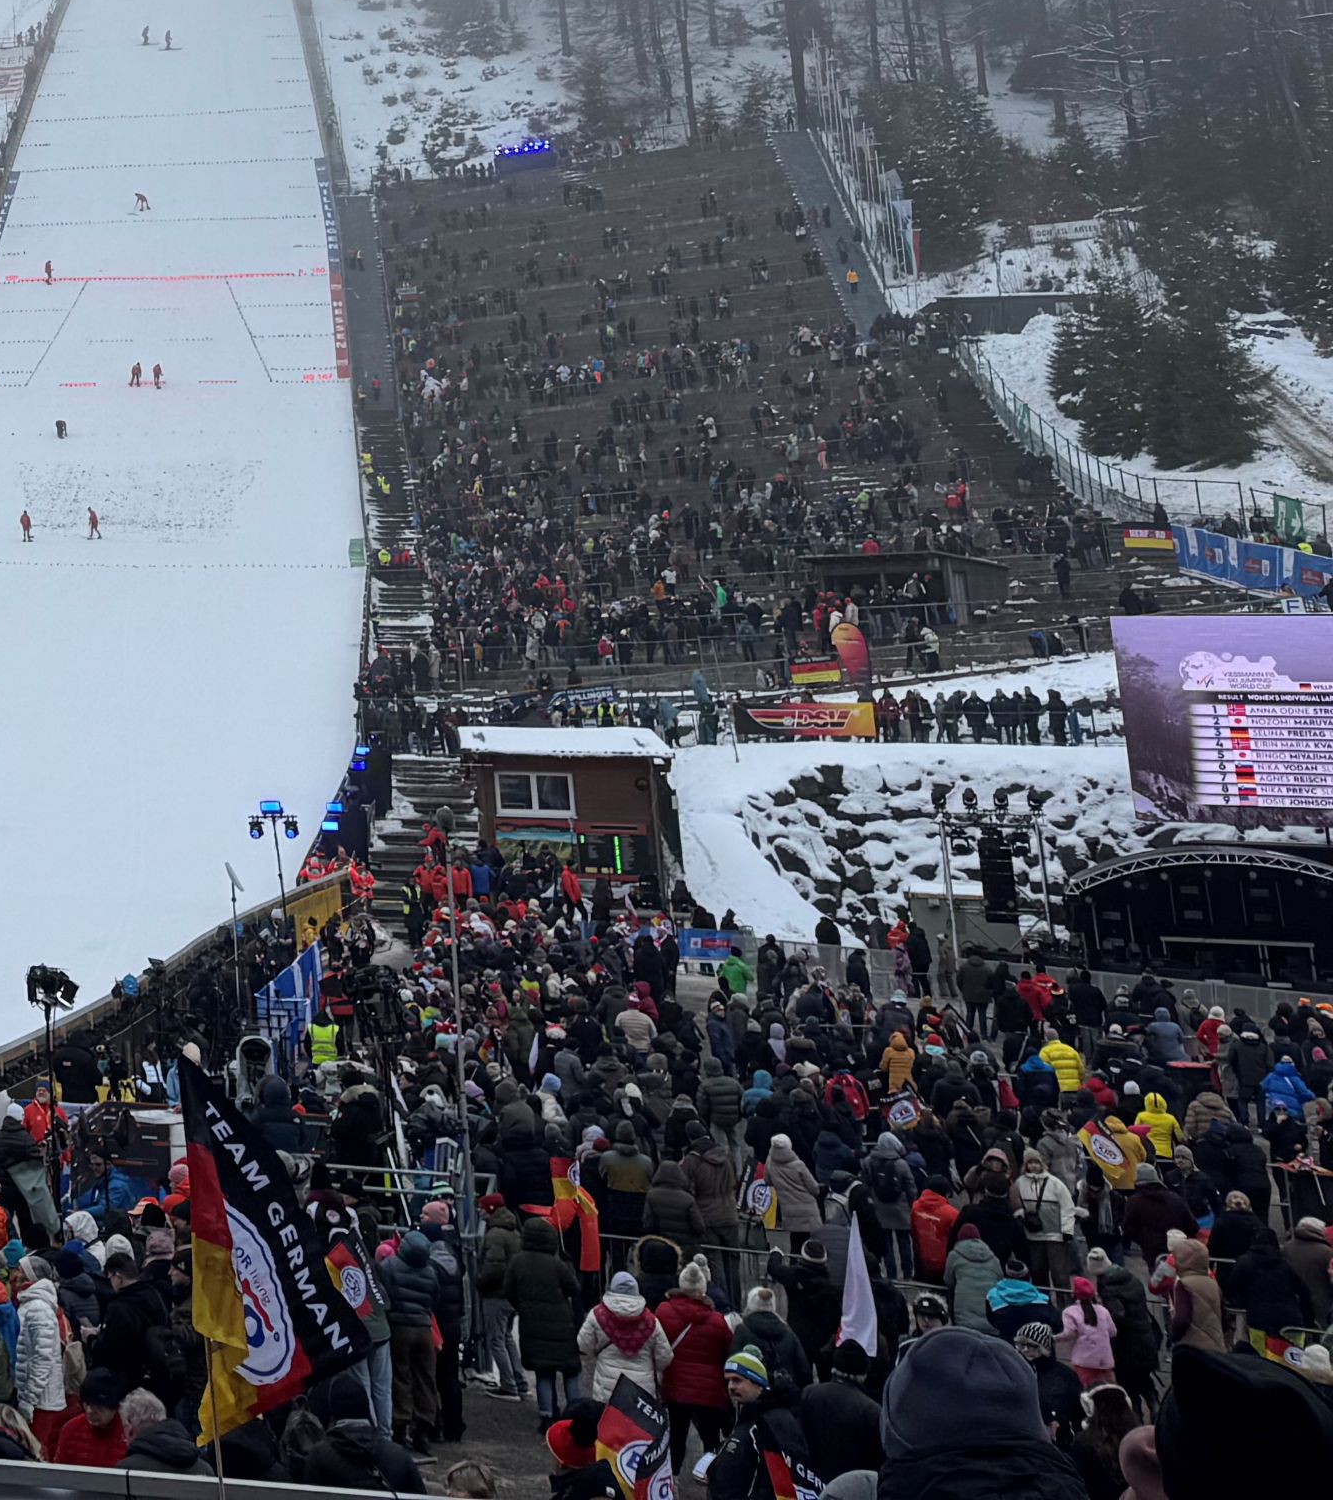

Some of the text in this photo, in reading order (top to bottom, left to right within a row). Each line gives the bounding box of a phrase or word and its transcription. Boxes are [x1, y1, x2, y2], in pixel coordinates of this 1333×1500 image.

[1287, 600, 1300, 613] F
[1212, 705, 1217, 714] 1
[797, 709, 851, 729] DSV
[1213, 717, 1220, 725] 2
[1251, 718, 1291, 726] NOZOMI
[1214, 728, 1326, 738] 3 SELINA FREITAG
[1216, 739, 1224, 748] 4
[1254, 739, 1278, 748] EIRIN
[1217, 750, 1333, 760] 5 RINGO MIYAJIMA
[1218, 762, 1226, 770] 6
[1220, 773, 1327, 783] 7 AGNES REISCH
[1221, 784, 1229, 793] 8
[1286, 787, 1318, 795] PREVC
[1222, 796, 1231, 804] 9
[1289, 798, 1333, 806] JOHNSON
[205, 1101, 271, 1192] TEAM
[235, 1246, 251, 1270] OR
[364, 1263, 386, 1306] GERMANY
